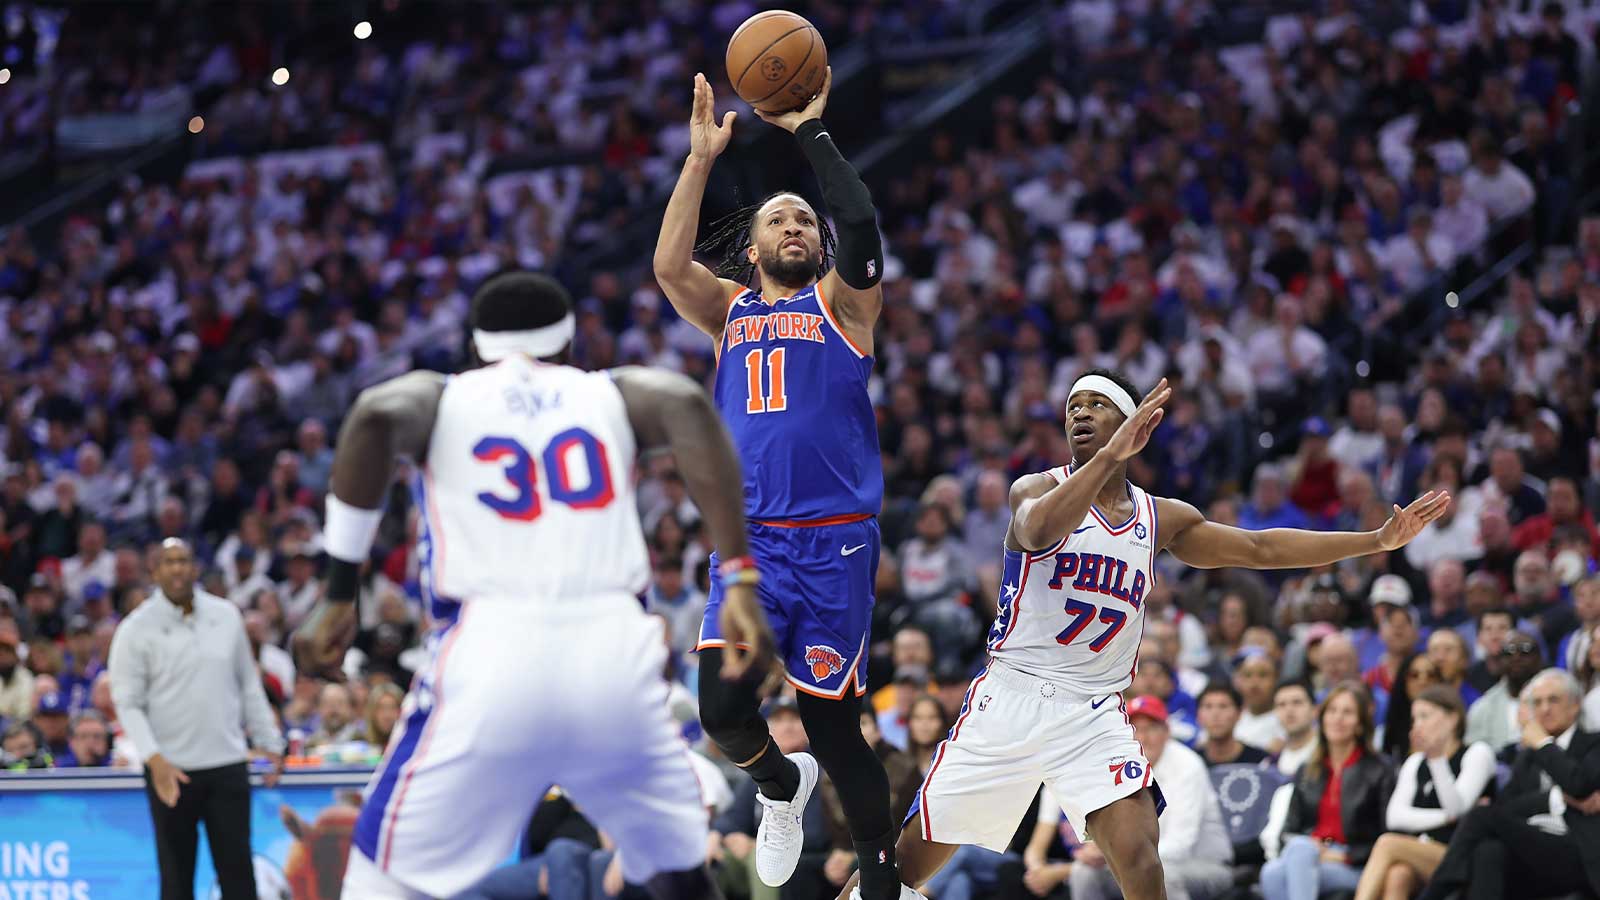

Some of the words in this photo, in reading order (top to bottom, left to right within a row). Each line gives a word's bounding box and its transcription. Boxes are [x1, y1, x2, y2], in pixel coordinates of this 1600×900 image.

[765, 312, 825, 344] YORK
[745, 347, 787, 414] 11
[472, 427, 615, 522] 30
[1048, 552, 1146, 612] PHILA
[1055, 598, 1128, 653] 77
[1109, 760, 1143, 786] 76
[2, 840, 70, 878] ING
